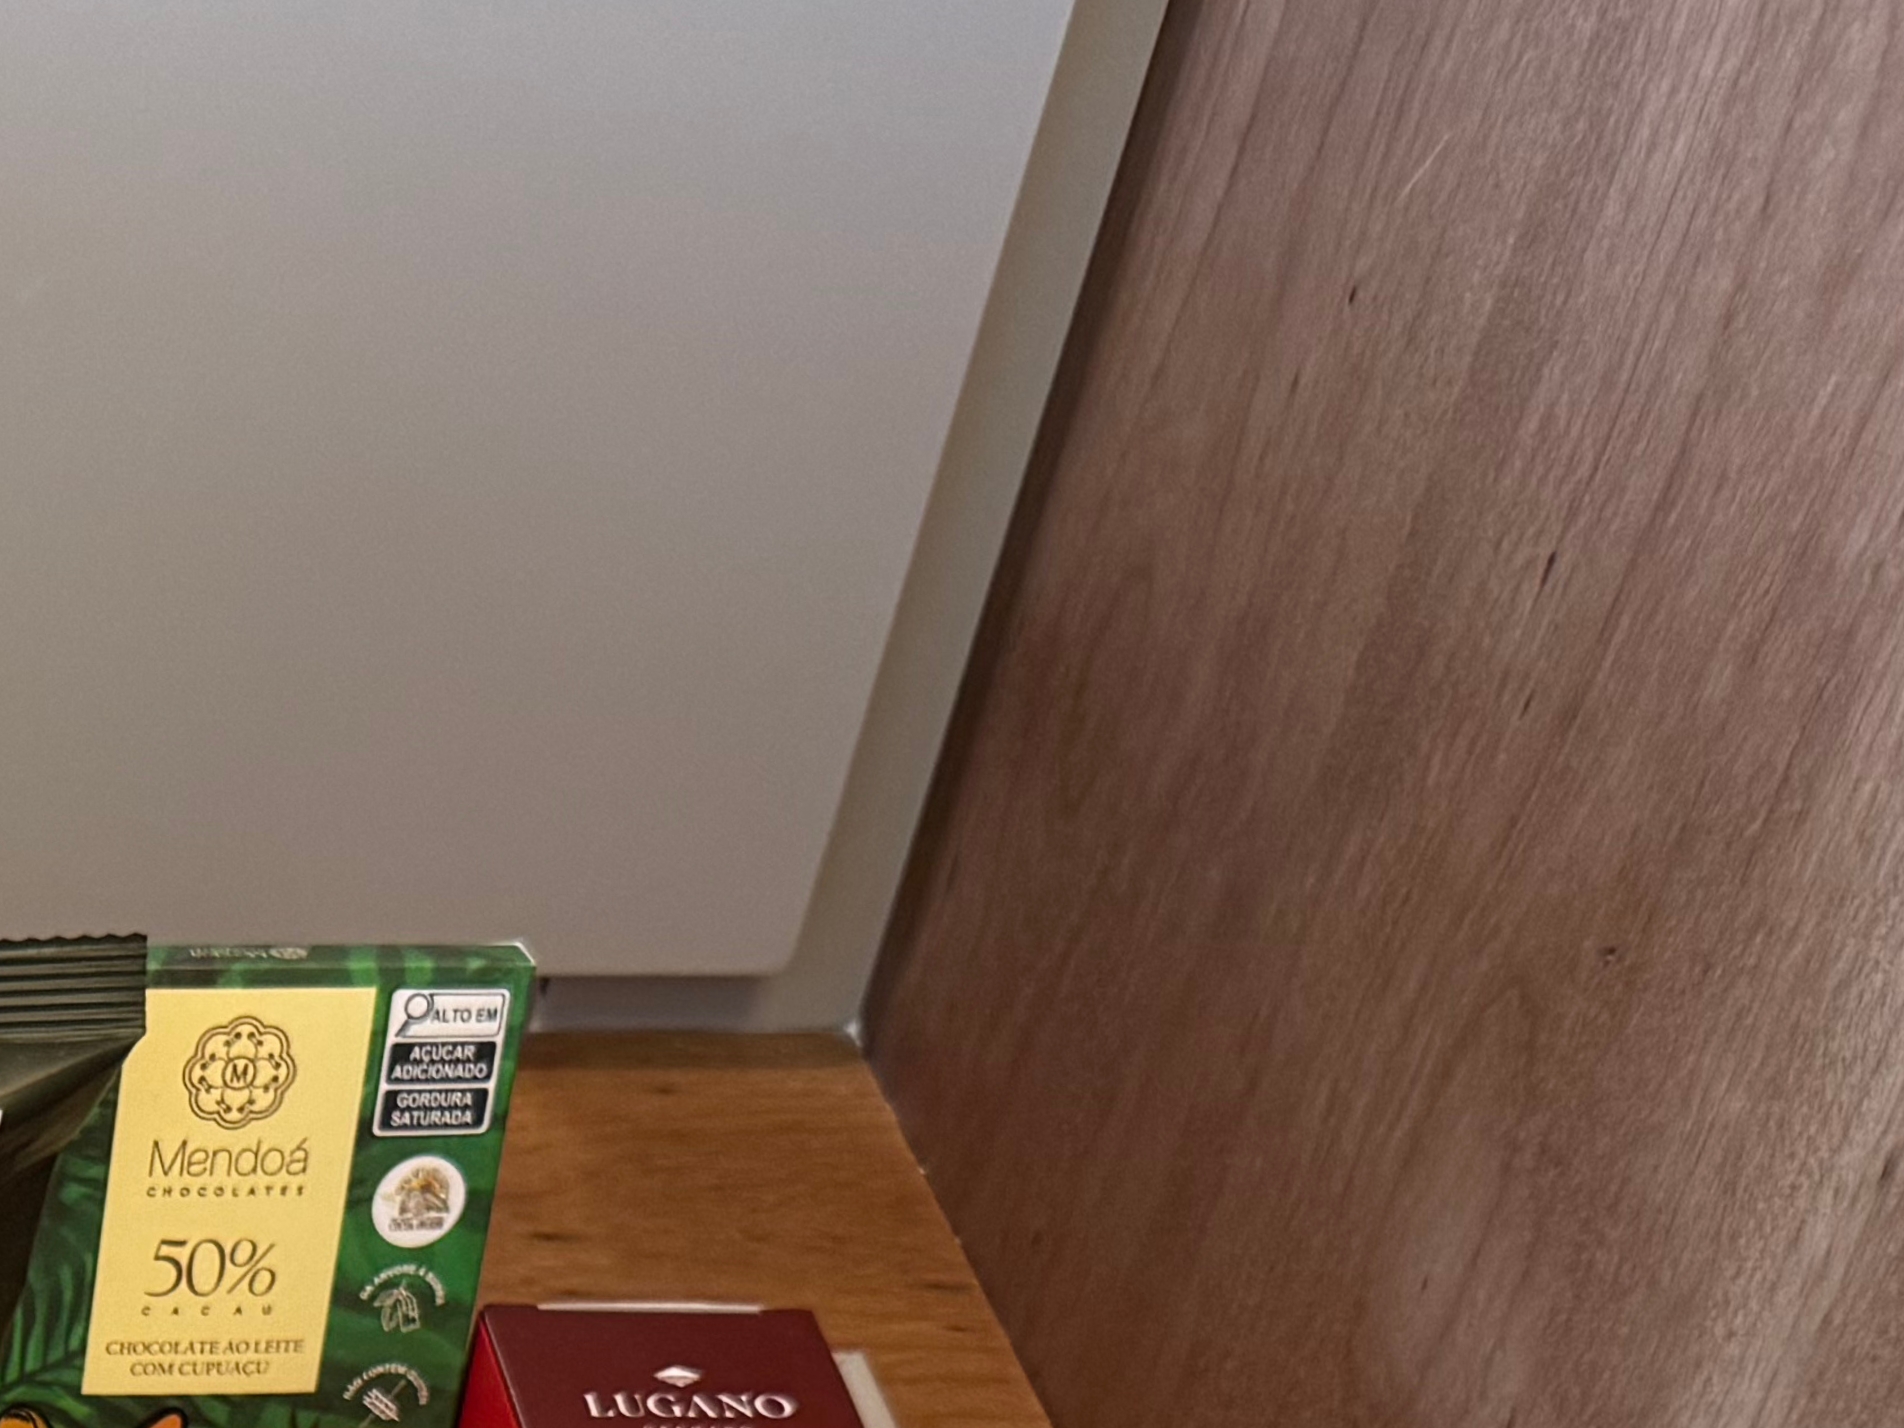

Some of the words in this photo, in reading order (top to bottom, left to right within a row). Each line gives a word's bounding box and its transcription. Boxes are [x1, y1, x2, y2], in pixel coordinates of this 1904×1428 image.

[431, 1009, 472, 1023] ALTO
[476, 1007, 498, 1023] EM
[391, 1063, 487, 1080] ADICIONADO
[396, 1092, 473, 1108] GORDURA
[390, 1110, 473, 1127] SATURADA
[148, 1136, 310, 1179] Mendoá
[146, 1185, 305, 1198] CHOCOLATES
[143, 1238, 277, 1298] 50%
[142, 1305, 273, 1317] CACAU
[105, 1339, 220, 1356] CHOCOLATE
[224, 1340, 249, 1355] AO
[253, 1338, 305, 1355] LEITE
[129, 1361, 175, 1377] COM
[178, 1360, 271, 1379] CUPUAÇU
[583, 1391, 799, 1419] LUGANO
